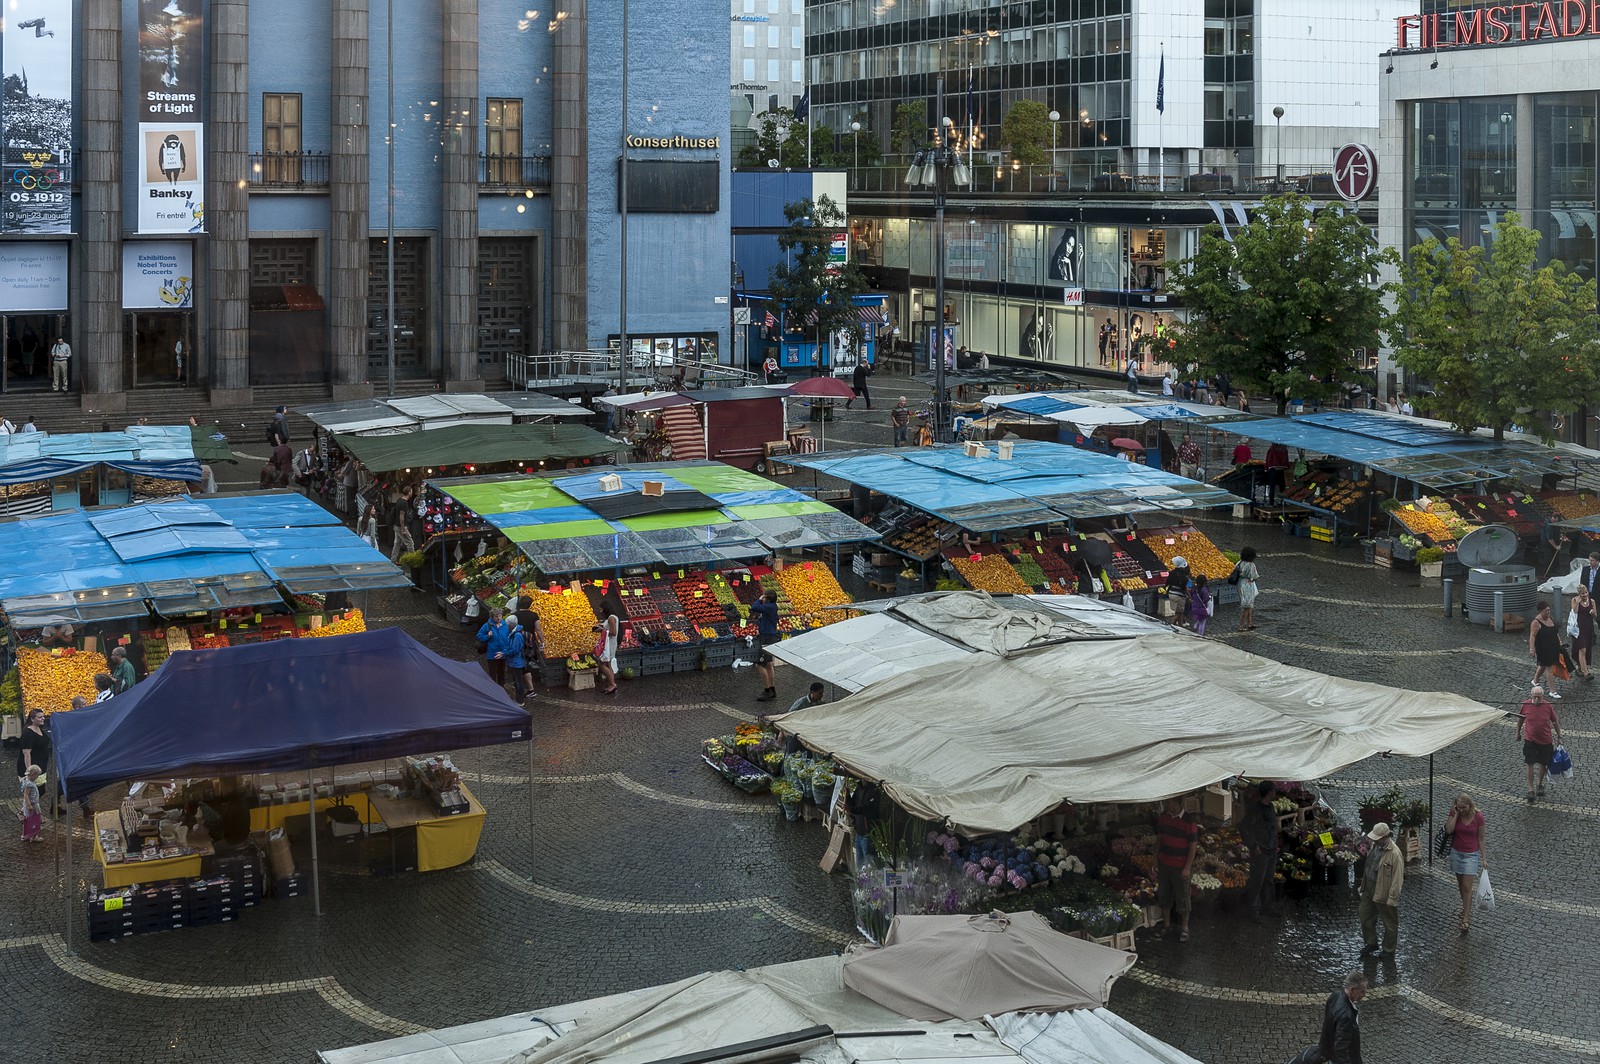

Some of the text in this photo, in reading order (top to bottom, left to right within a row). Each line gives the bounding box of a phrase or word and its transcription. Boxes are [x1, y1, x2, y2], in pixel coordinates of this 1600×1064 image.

[1397, 0, 1600, 48] FILMSTAD
[147, 91, 196, 101] Streams
[149, 103, 194, 115] of Light
[626, 134, 720, 148] Konserthuset
[10, 192, 64, 202] OS 1912
[149, 189, 193, 199] Banksy
